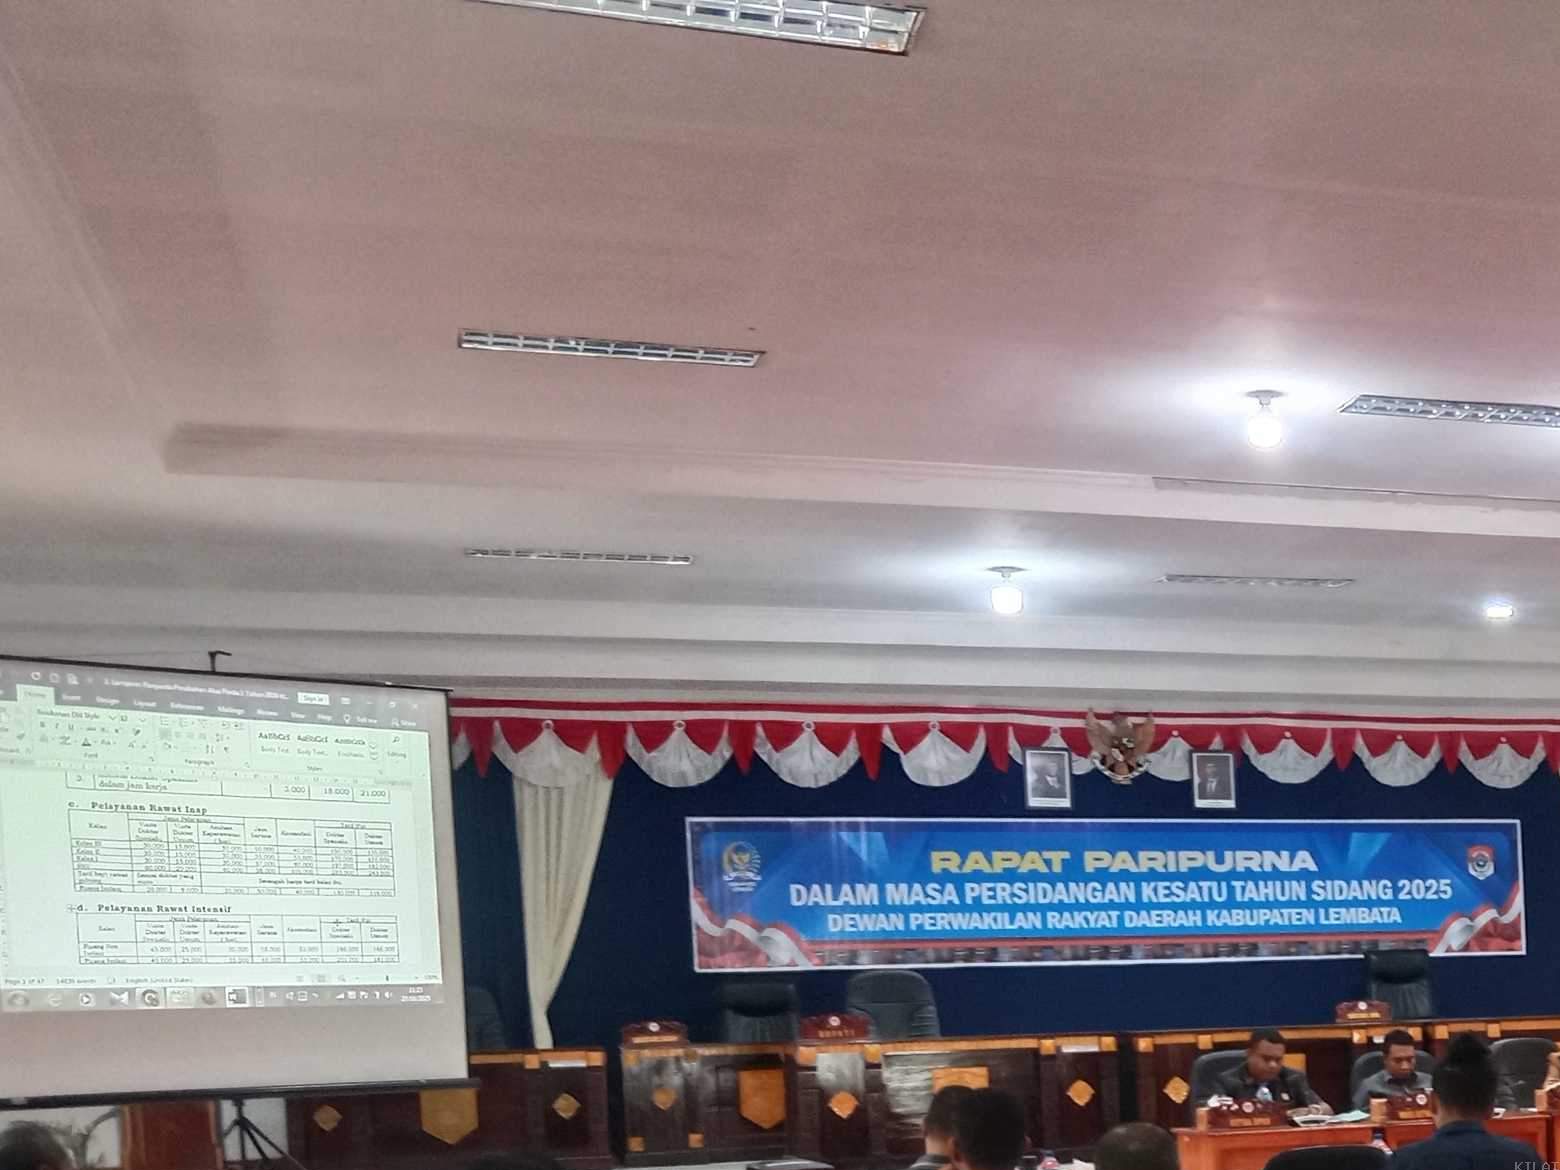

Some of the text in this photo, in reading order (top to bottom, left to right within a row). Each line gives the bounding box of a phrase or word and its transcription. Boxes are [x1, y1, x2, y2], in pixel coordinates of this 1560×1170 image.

[91, 801, 146, 812] Pelayanan
[149, 803, 182, 813] Rawat
[185, 805, 208, 816] Inap
[930, 849, 1319, 874] RAPAT PARIPURNA
[789, 878, 1453, 907] DALAM MASA PERSIDANGAN KESATU TAHUN SIDANG 2025
[98, 903, 153, 914] Pelayanan
[156, 905, 188, 913] Rawat
[191, 905, 232, 913] Intensif
[827, 906, 1402, 933] DEWAN PERWAKILAN RAKYAT DAERAH KABUPATEN LEMBATA
